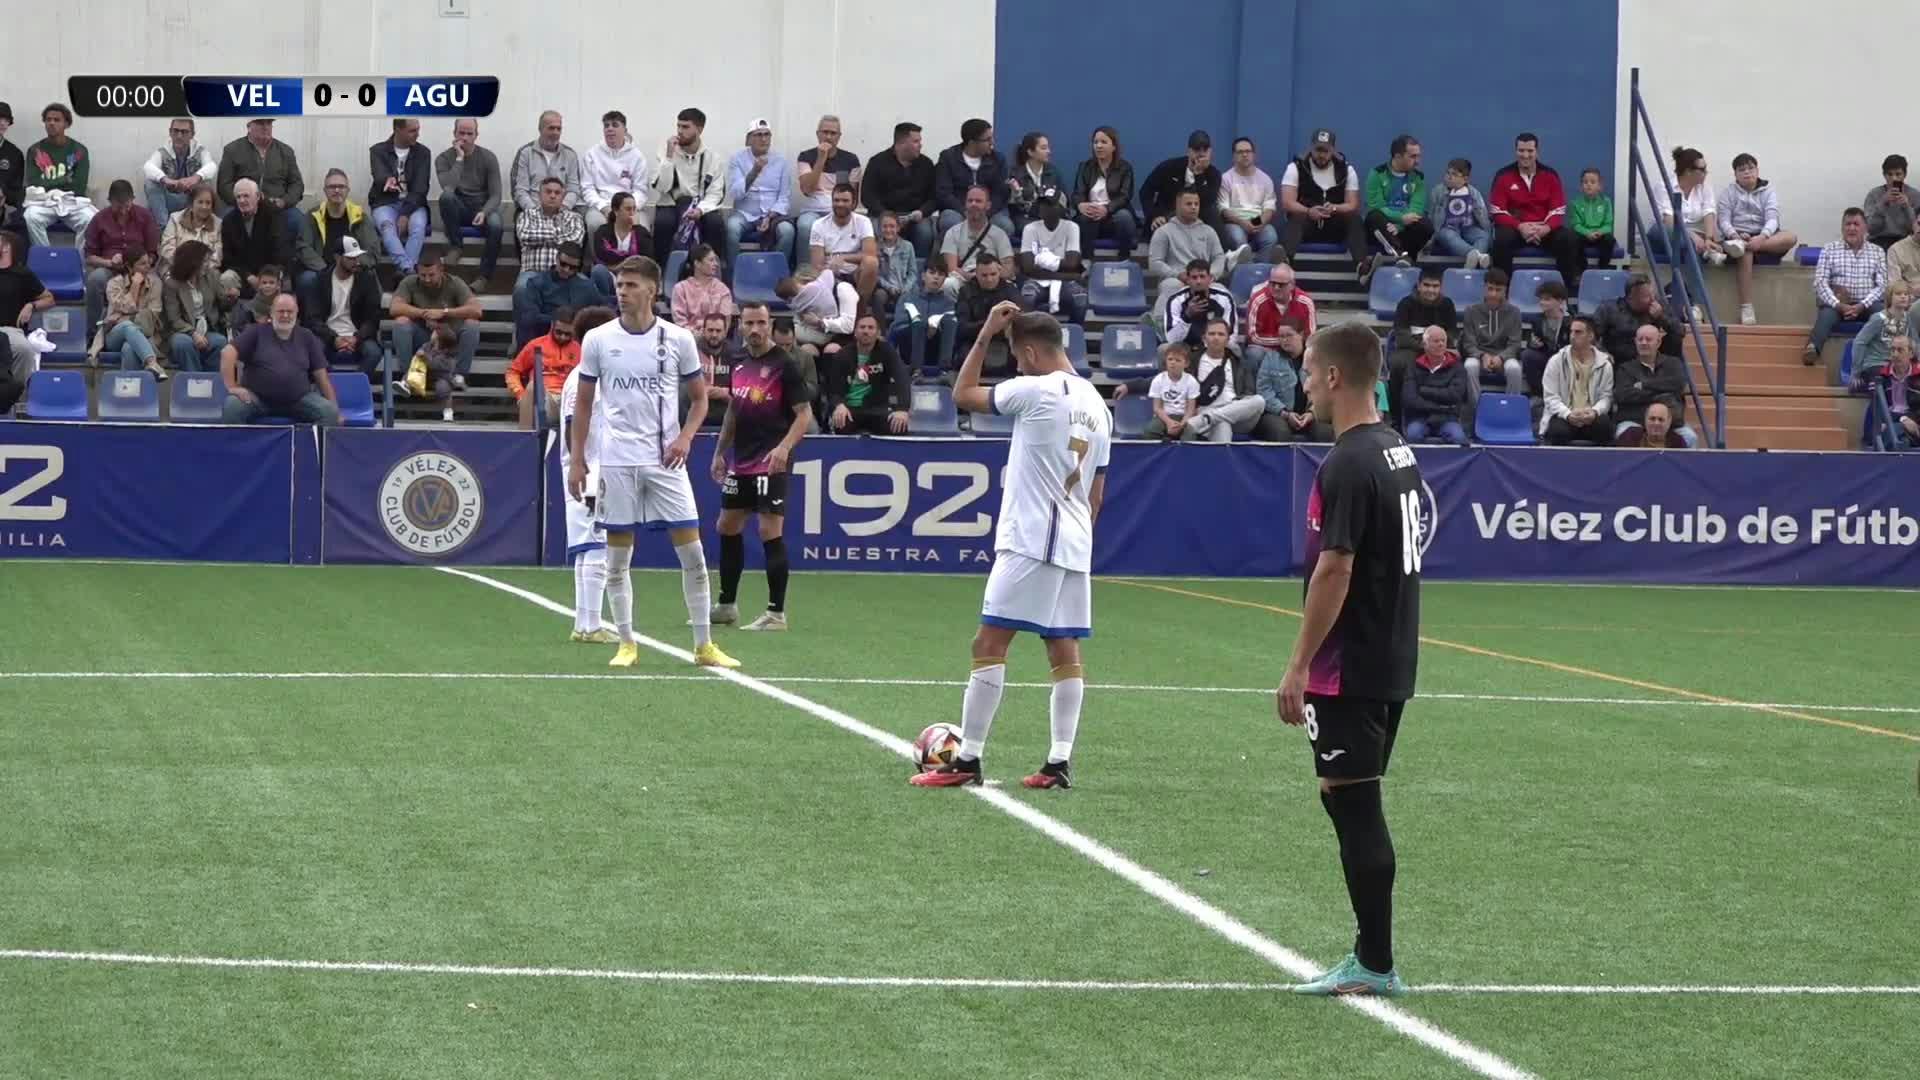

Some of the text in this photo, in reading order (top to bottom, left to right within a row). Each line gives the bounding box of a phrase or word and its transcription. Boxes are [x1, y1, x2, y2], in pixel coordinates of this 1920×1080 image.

[612, 377, 665, 390] AVATEL
[405, 456, 457, 477] VÉLEZ
[1063, 435, 1089, 501] 7
[792, 458, 1008, 538] 192
[0, 532, 67, 547] ILIA
[385, 496, 409, 536] CLUB
[407, 531, 430, 549] DE
[434, 497, 477, 548] FÚTBOL
[1400, 488, 1422, 575] 18
[1471, 499, 1602, 542] Vélez
[1613, 504, 1728, 543] Club
[1737, 506, 1800, 544] de
[1811, 504, 1919, 545] Fútb
[803, 547, 992, 562] NUESTRA FA
[1304, 703, 1320, 741] 8
